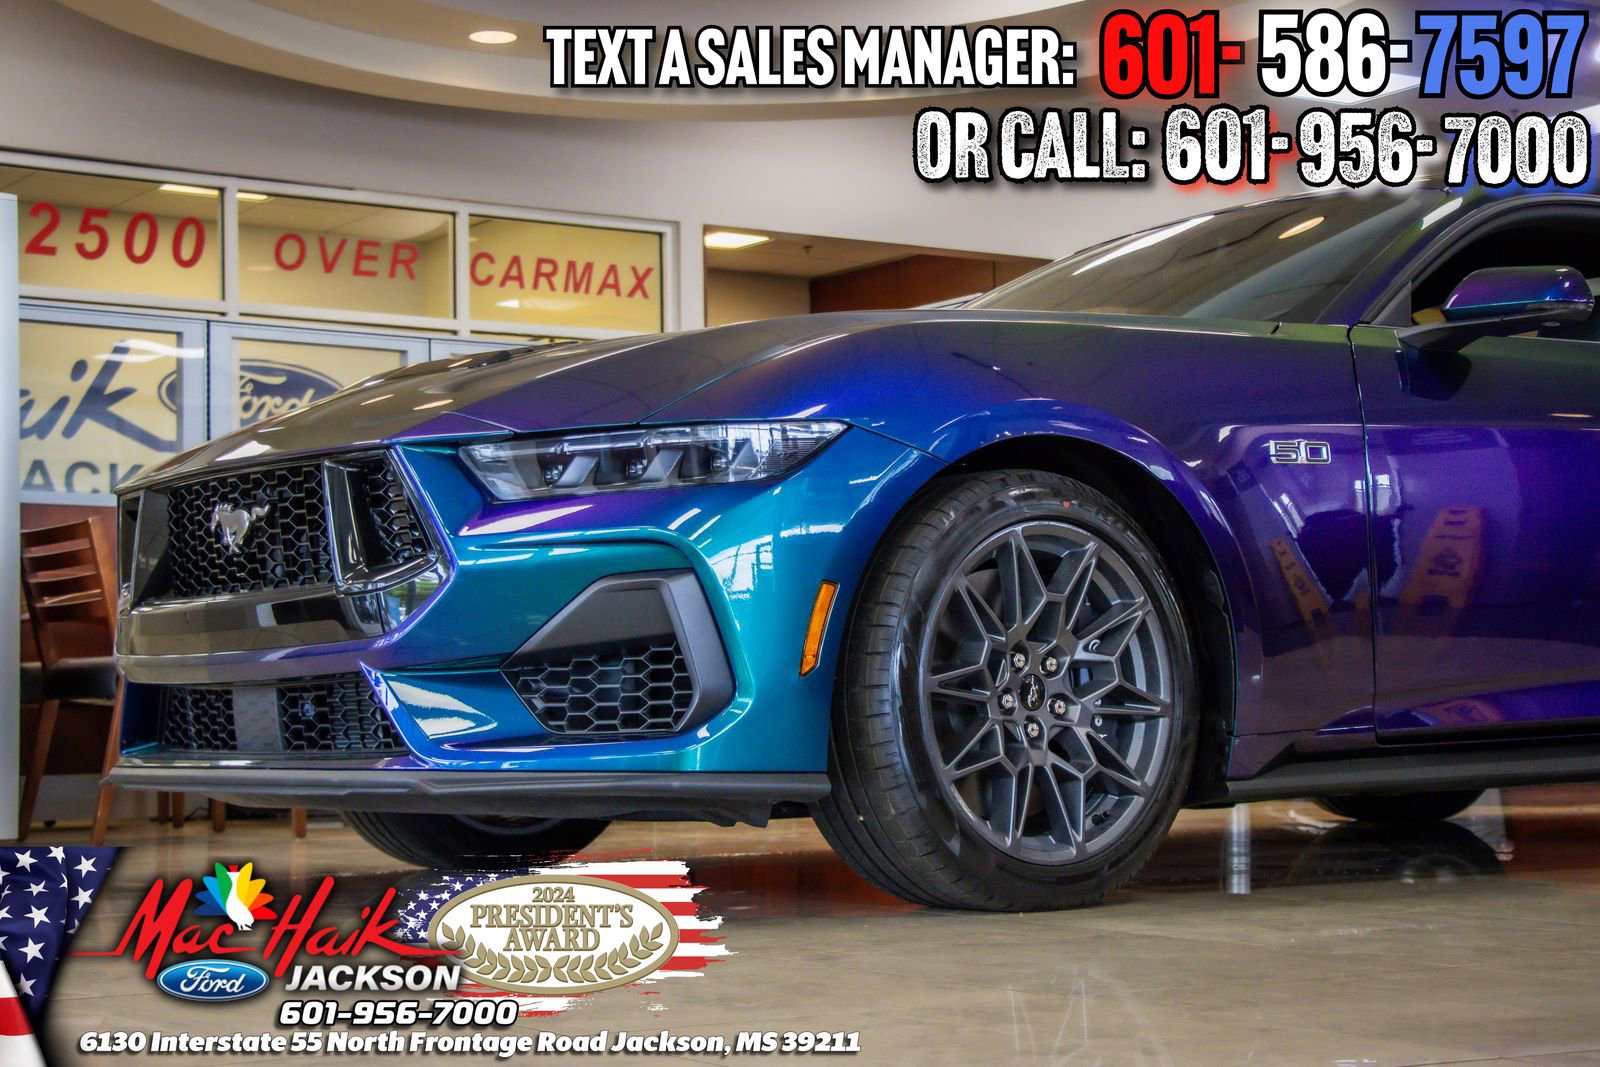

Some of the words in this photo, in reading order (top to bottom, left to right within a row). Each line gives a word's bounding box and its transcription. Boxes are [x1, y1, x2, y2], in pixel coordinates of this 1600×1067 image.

[25, 201, 206, 268] 2500
[274, 233, 420, 281] OVER
[470, 252, 654, 300] CARMAX
